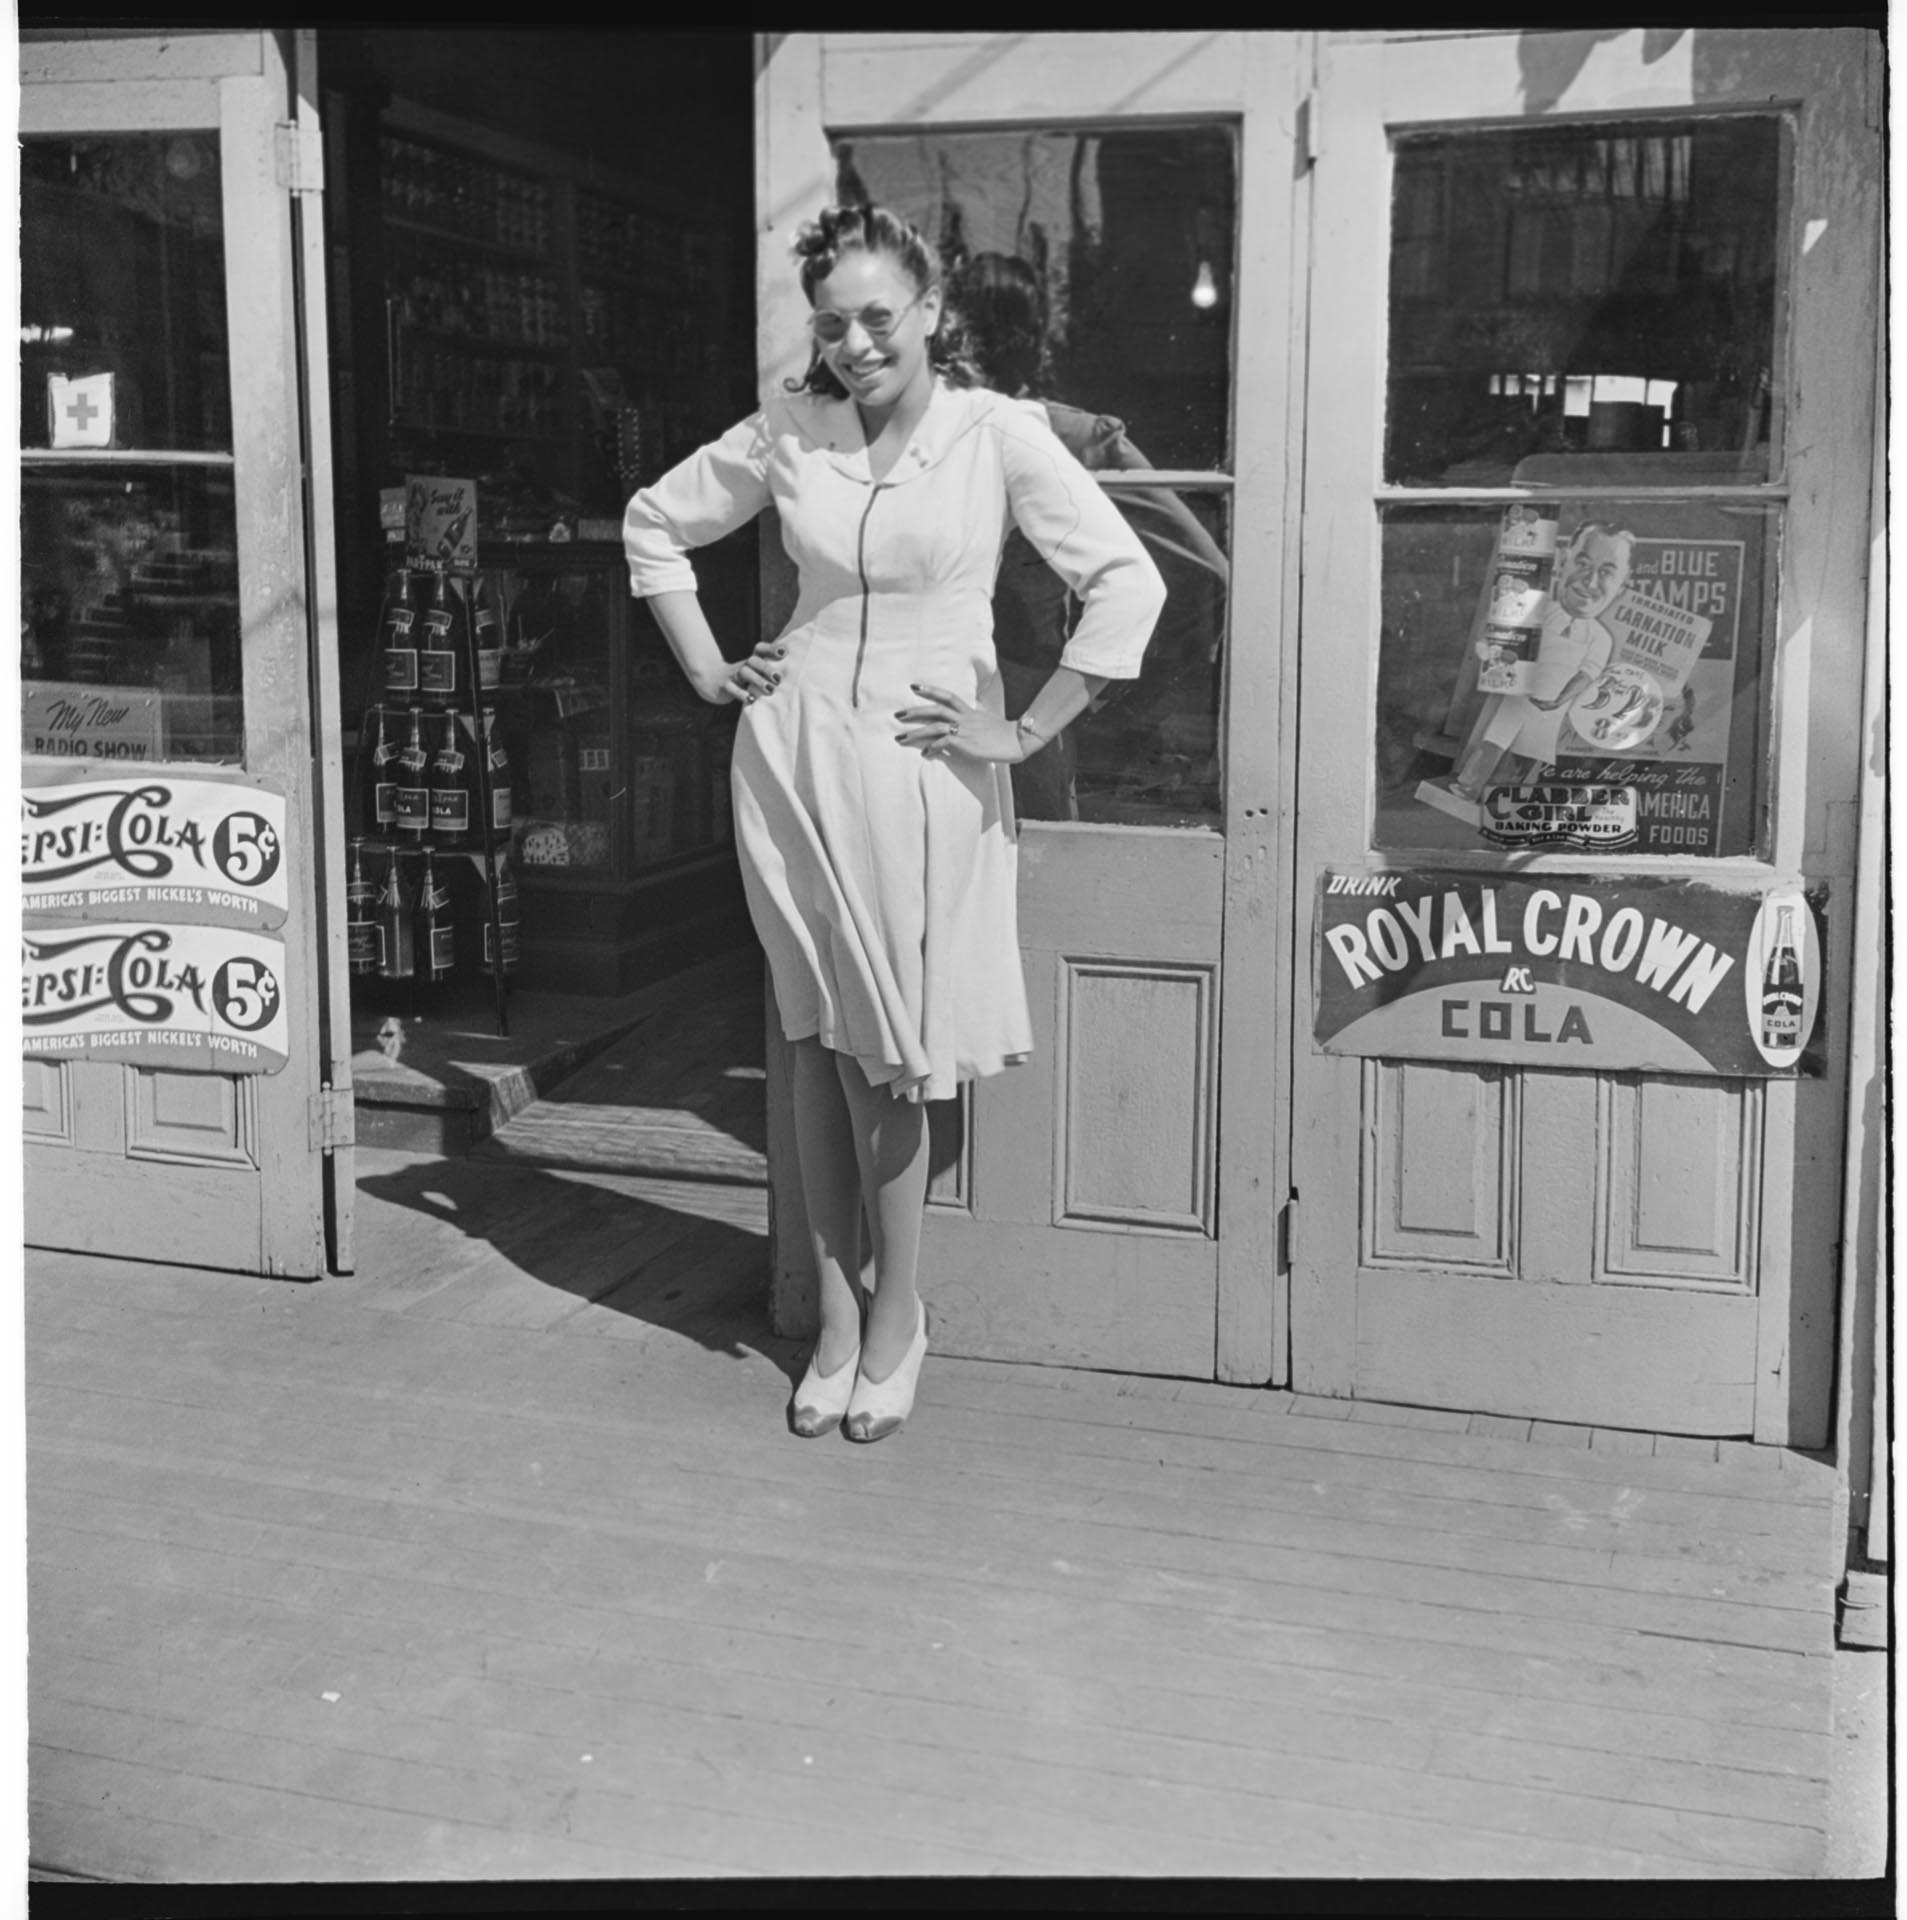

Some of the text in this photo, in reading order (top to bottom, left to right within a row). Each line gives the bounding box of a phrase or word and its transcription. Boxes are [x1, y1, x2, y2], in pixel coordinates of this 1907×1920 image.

[1637, 550, 1719, 577] and BLUE
[1629, 579, 1726, 614] TAMPS
[1631, 594, 1695, 625] IRRADIATED
[1614, 604, 1697, 649] CARNATION
[1625, 629, 1668, 657] MILK
[46, 697, 130, 737] My New
[35, 737, 146, 760] RADIO SHOW
[1560, 767, 1591, 780] are
[1597, 760, 1668, 788] helping
[1485, 786, 1630, 820] CLABBER
[1516, 805, 1592, 822] GIRL
[1495, 822, 1622, 833] BAKING POWDER
[1649, 825, 1709, 845] FOODS
[226, 815, 276, 882] 5¢
[22, 887, 258, 913] AMERICA'S BIGGEST NICKEL'S WORTH
[1326, 875, 1402, 897] DRINK
[1325, 888, 1735, 1015] ROYAL CROWN
[1502, 966, 1534, 993] RC
[225, 961, 276, 1028] 5¢
[1441, 999, 1594, 1045] COLA
[1767, 1019, 1796, 1027] COLA
[23, 1031, 258, 1058] AMERICA'S BIGGEST NICKEL'S WORTH
